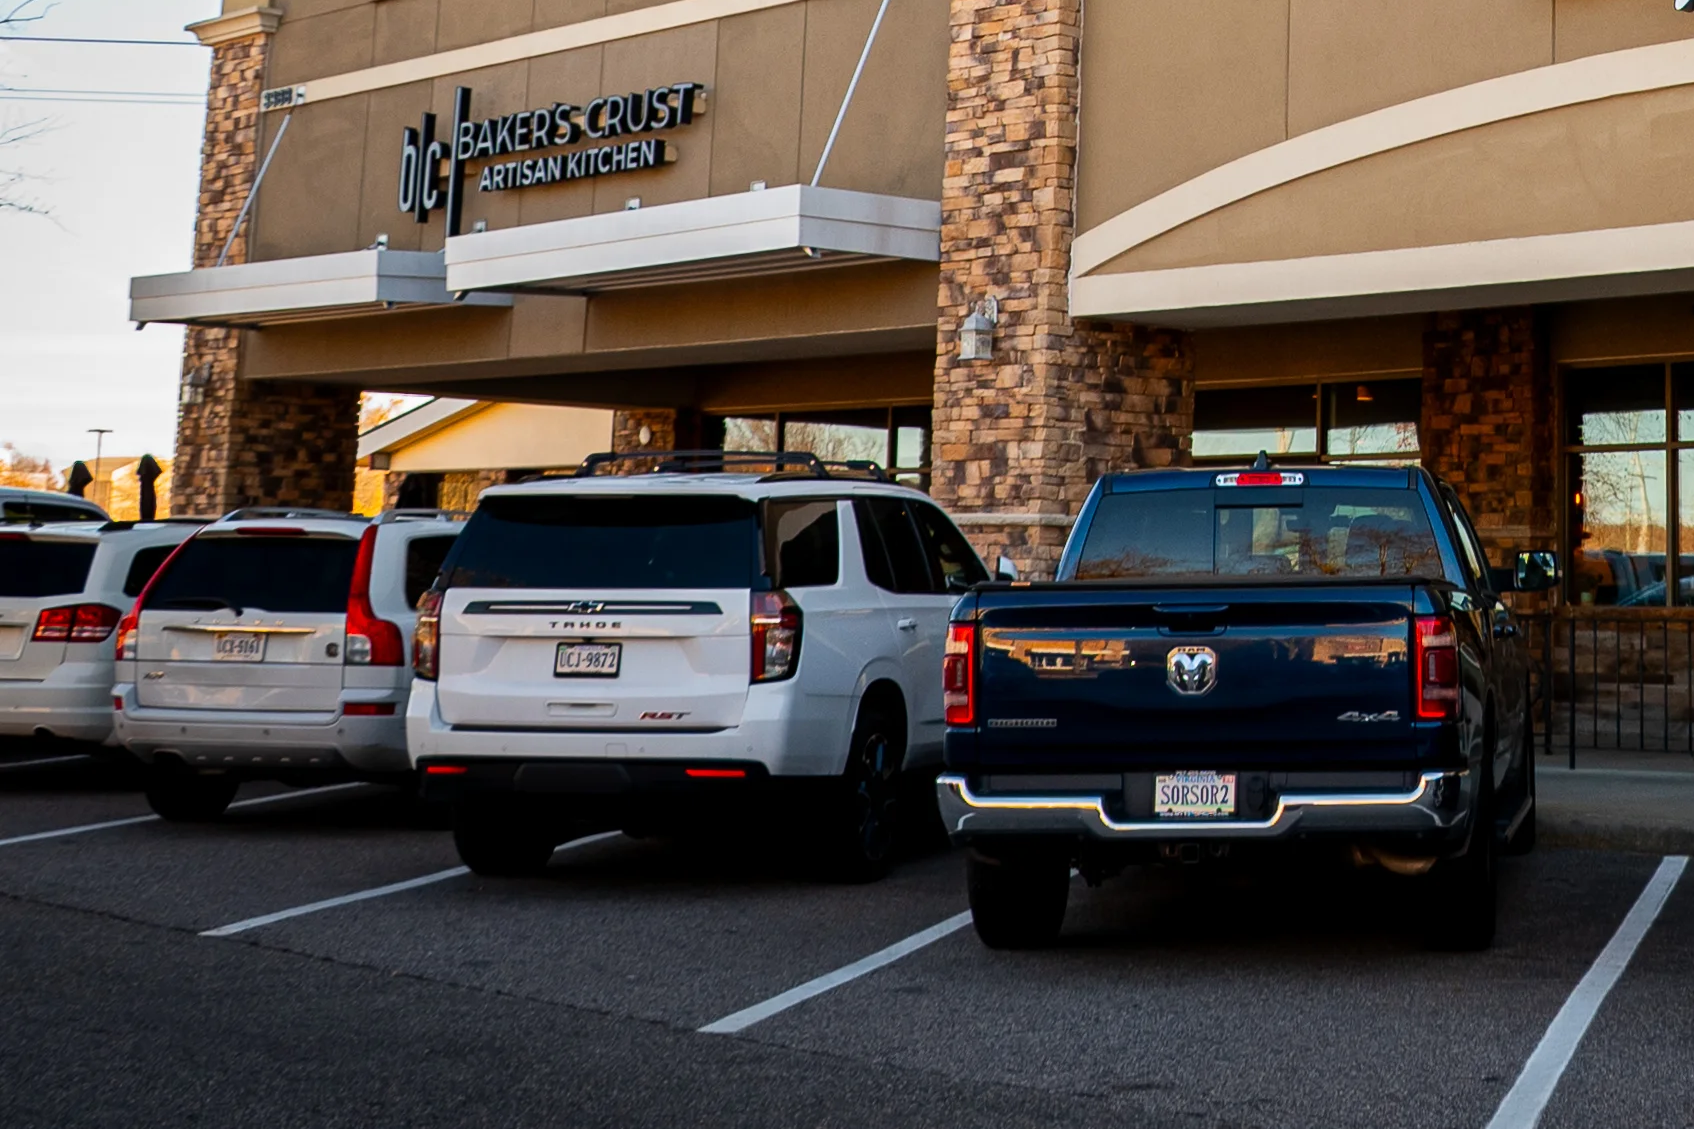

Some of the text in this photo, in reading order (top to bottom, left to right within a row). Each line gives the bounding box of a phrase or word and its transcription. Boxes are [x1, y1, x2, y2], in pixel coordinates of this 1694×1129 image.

[457, 82, 697, 161] BAKER'S CRUST
[478, 139, 657, 191] ARTISAN KITCHEN
[549, 621, 622, 629] TAHOE
